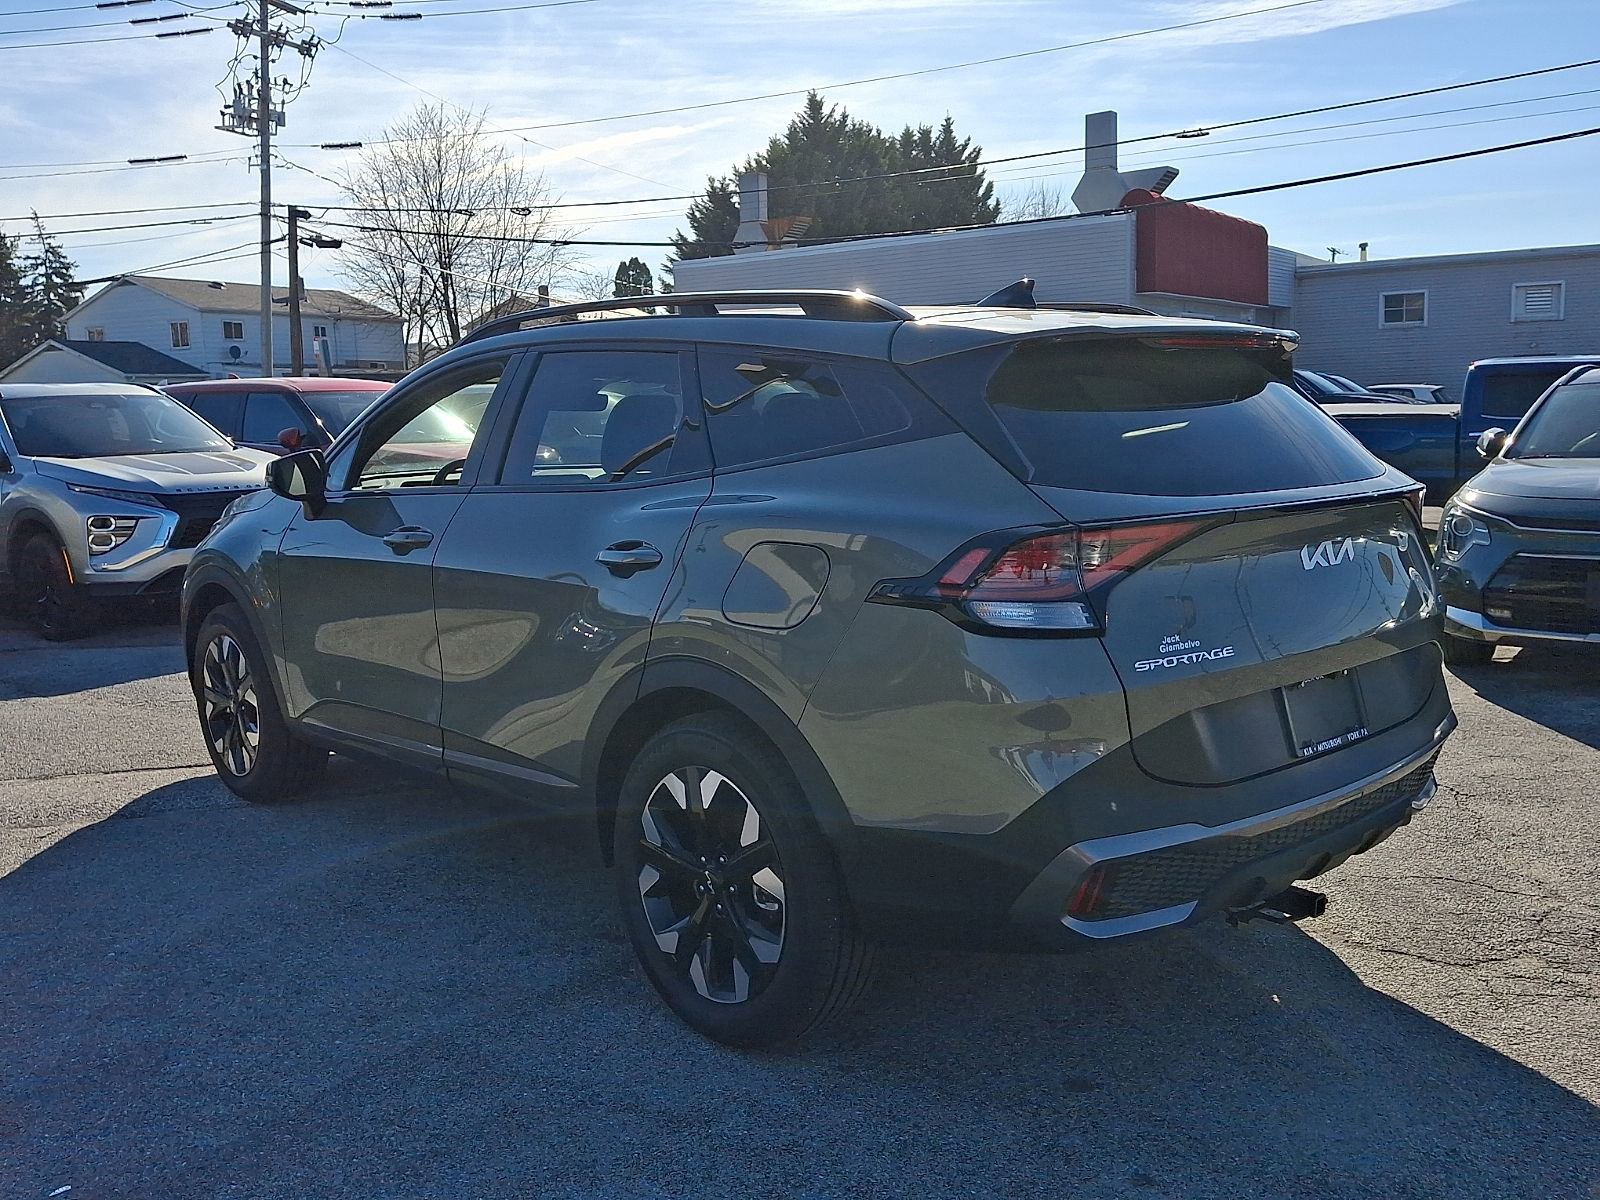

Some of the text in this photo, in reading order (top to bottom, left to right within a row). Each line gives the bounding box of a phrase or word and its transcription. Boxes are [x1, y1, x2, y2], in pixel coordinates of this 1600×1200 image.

[1301, 536, 1354, 570] KIA
[1162, 634, 1180, 644] Jack
[1159, 640, 1200, 653] Giambalvo
[1134, 646, 1235, 672] SPORTAGE
[1303, 746, 1314, 757] KIA
